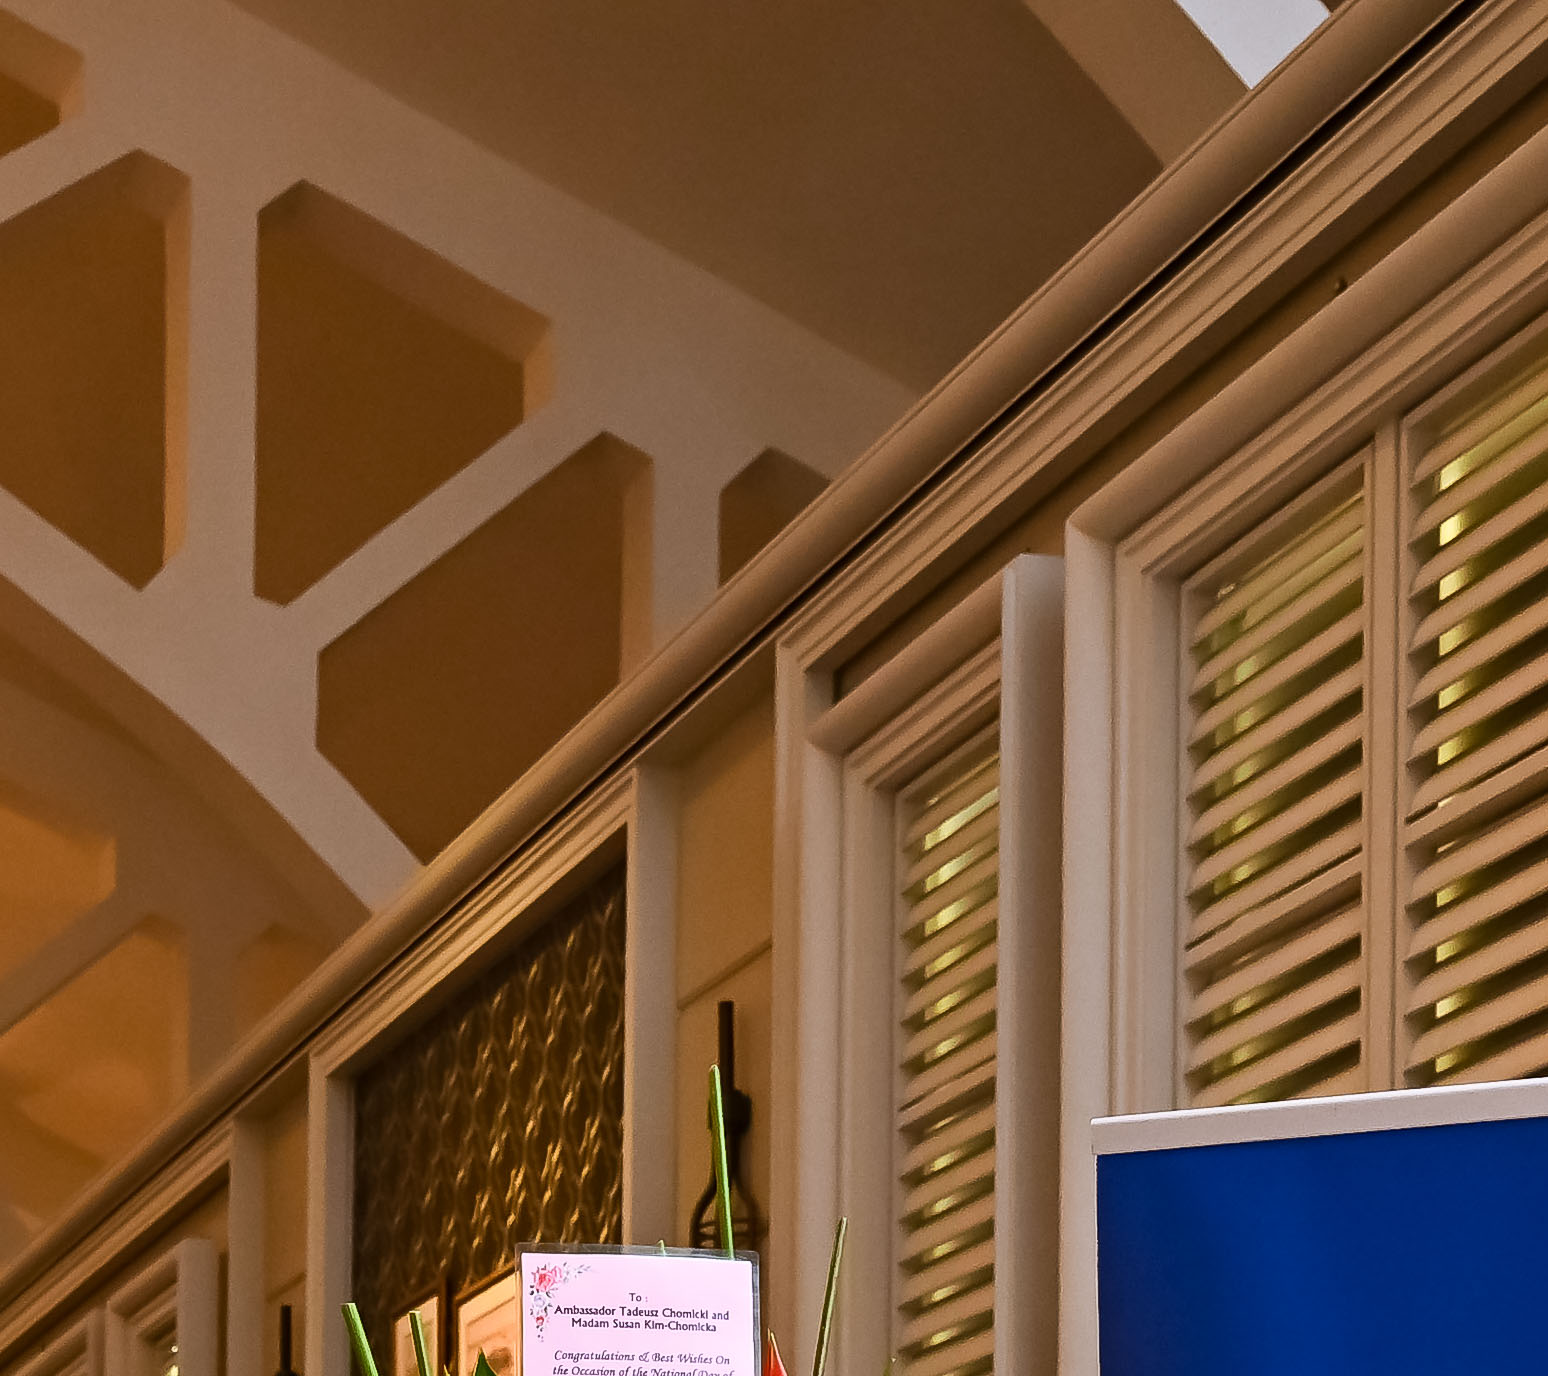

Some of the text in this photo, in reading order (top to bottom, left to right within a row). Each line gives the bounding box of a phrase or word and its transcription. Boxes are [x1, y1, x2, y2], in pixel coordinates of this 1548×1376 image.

[629, 1293, 641, 1301] To
[554, 1305, 729, 1320] Ambassador Tadeusz Chomicki and
[572, 1318, 716, 1331] Madam Susan Kim-Chomicka
[555, 1350, 729, 1364] Congratulations & Best Wishes On
[553, 1365, 568, 1375] the
[572, 1366, 615, 1376] Occasion
[633, 1367, 647, 1376] the
